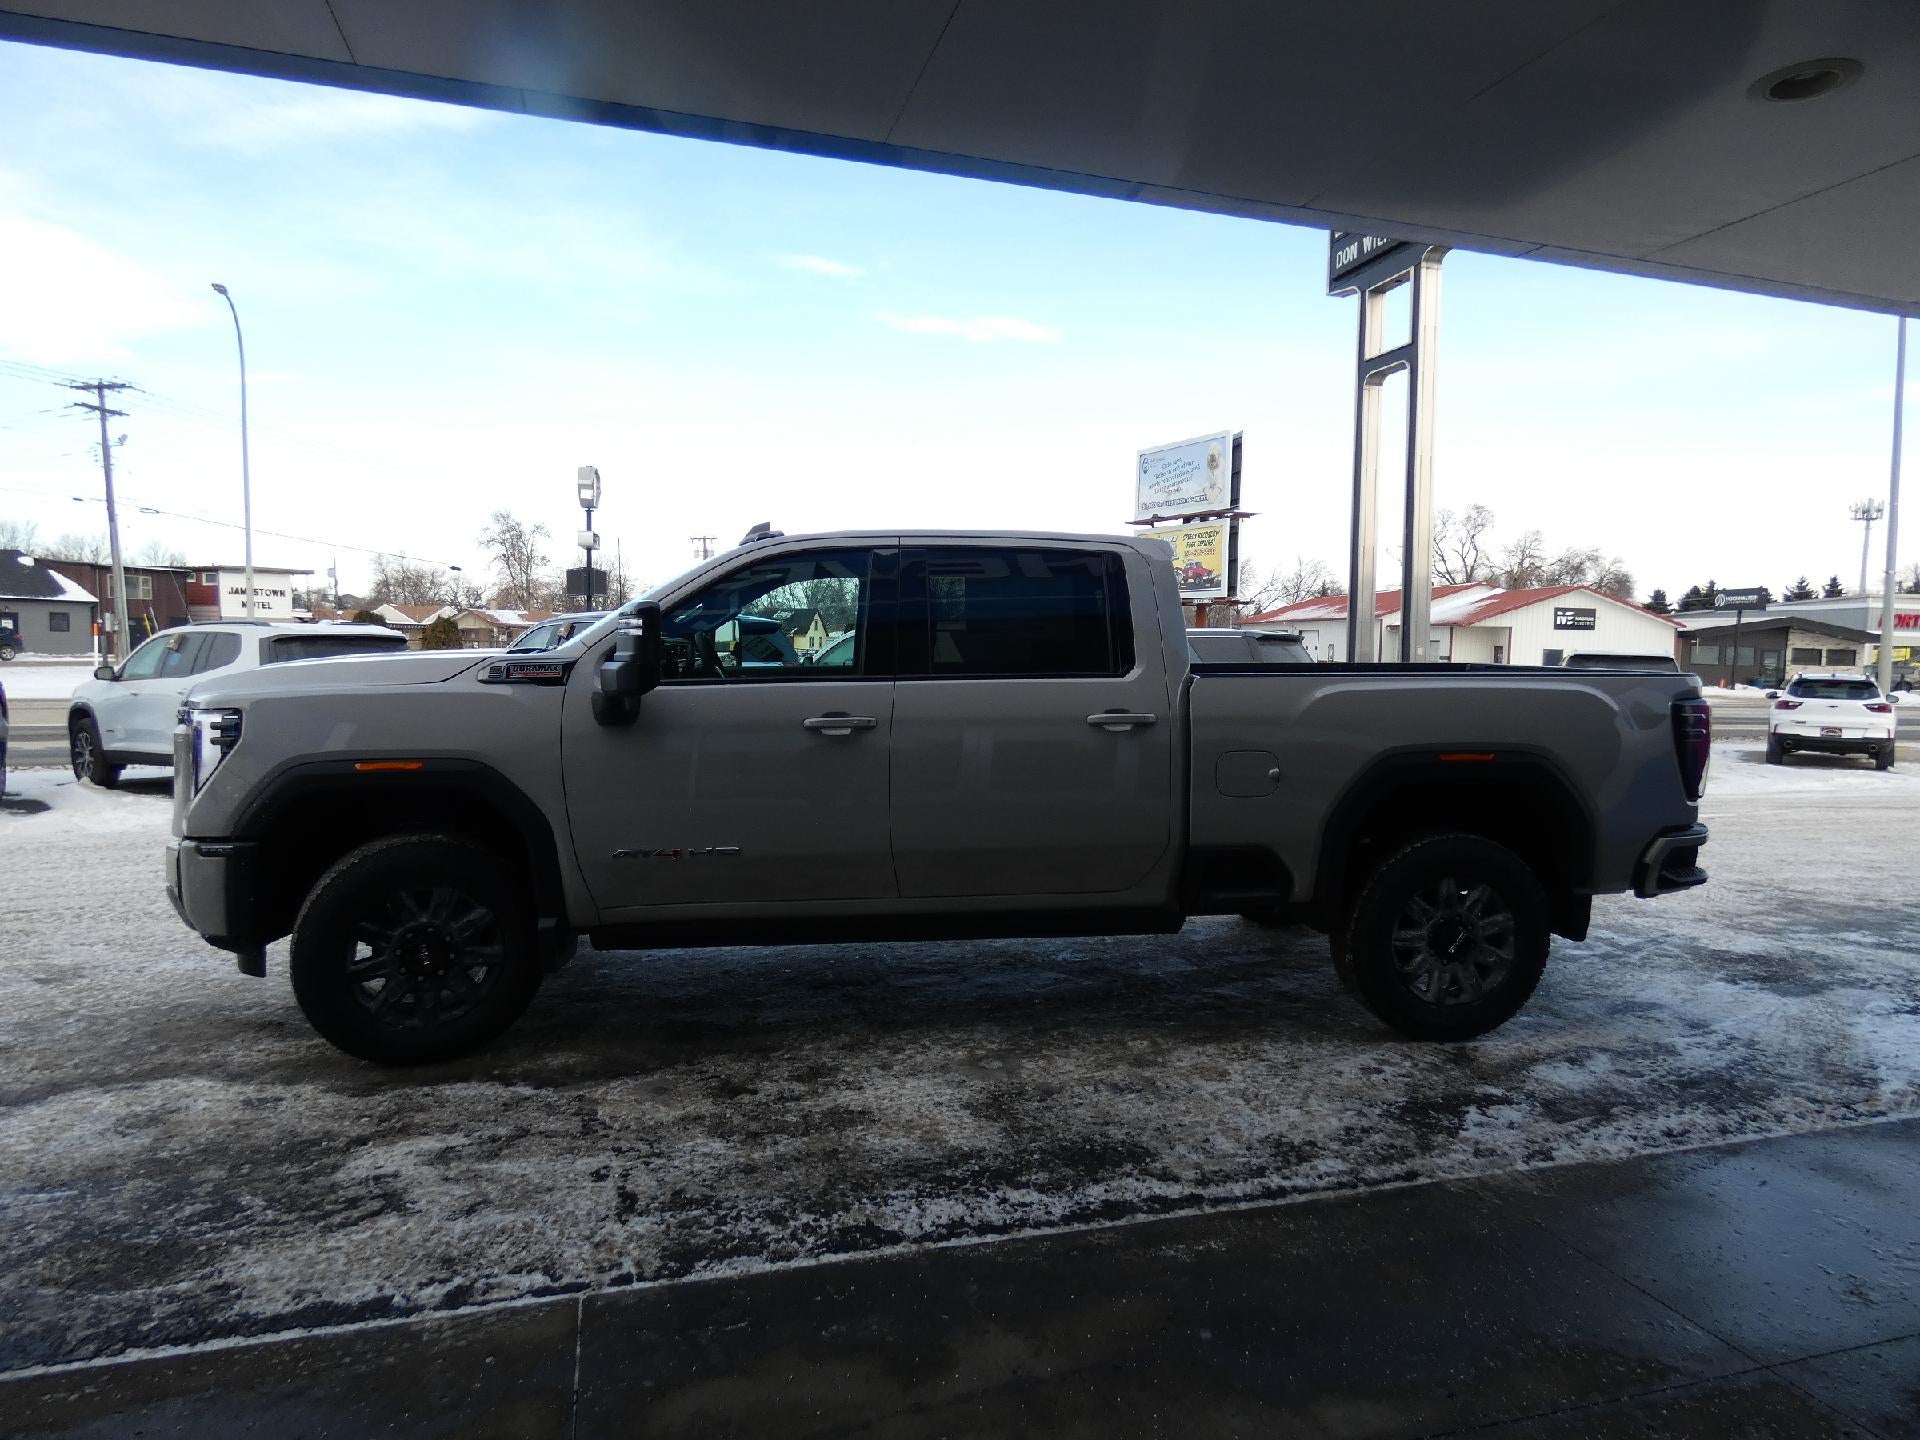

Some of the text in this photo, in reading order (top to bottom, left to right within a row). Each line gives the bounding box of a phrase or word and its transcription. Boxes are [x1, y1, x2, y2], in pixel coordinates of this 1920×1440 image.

[1336, 241, 1358, 270] DON
[228, 586, 286, 598] JAMSTOWN
[241, 600, 273, 610] MTEL
[513, 664, 559, 672] DURAMAX
